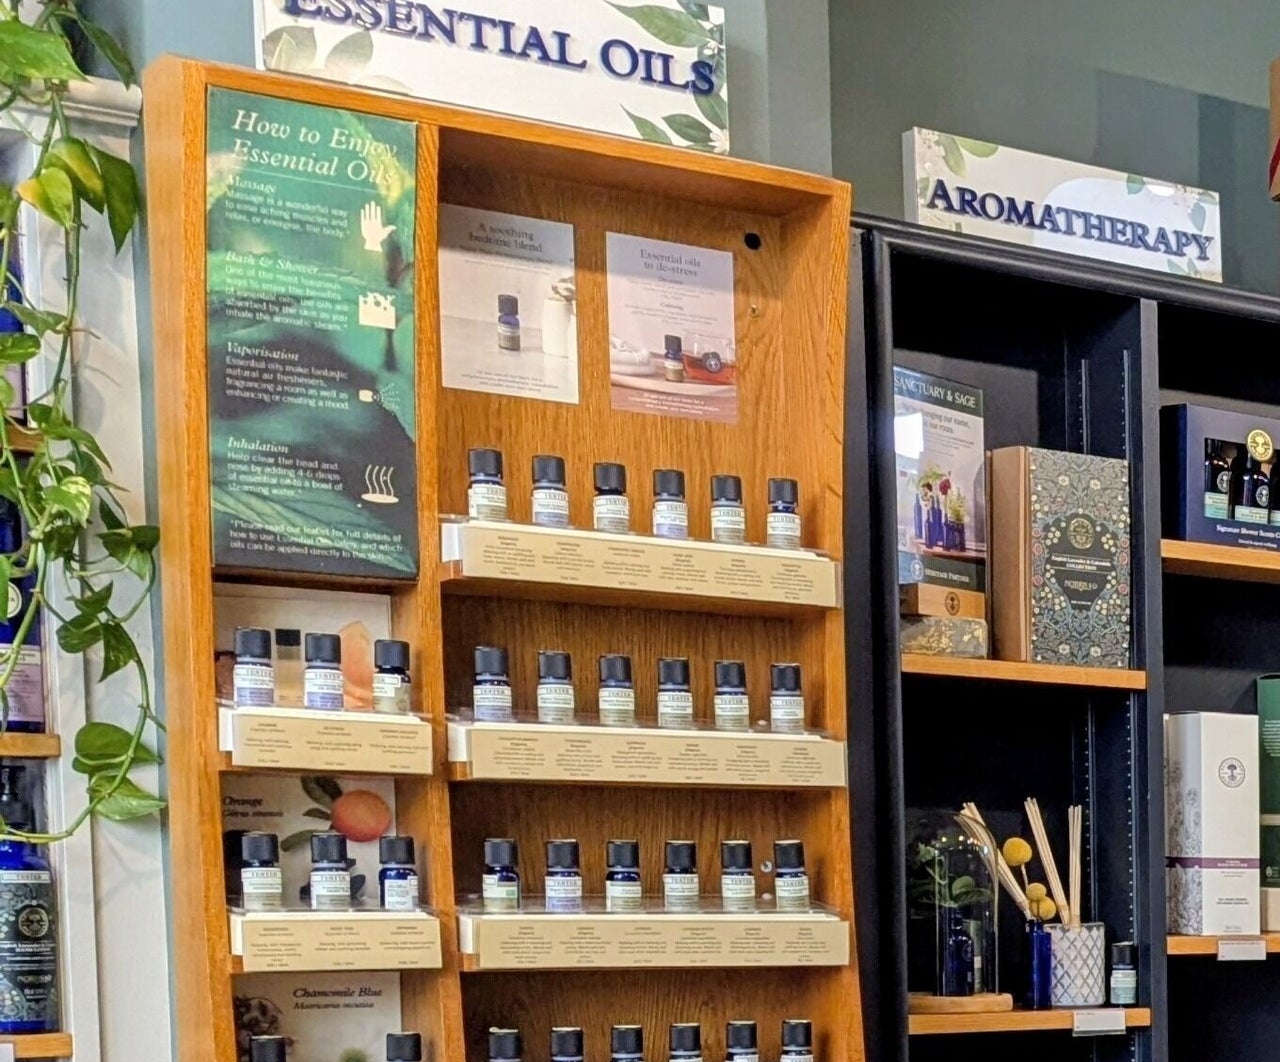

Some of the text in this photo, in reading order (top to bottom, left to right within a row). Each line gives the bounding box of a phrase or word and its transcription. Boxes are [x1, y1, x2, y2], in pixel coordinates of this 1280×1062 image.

[284, 0, 716, 96] ESSENTIAL OILS
[232, 109, 397, 158] How to Enjoy
[232, 138, 392, 186] Essential Oils
[926, 178, 1214, 260] AROMATHERAPY
[469, 231, 543, 253] bedtime blend
[478, 222, 534, 241] A soothing
[225, 252, 255, 265] Bath
[275, 259, 319, 274] Shower
[640, 248, 702, 268] Essential oils
[643, 259, 698, 277] to de-stress
[227, 341, 300, 362] Vaporisation
[894, 376, 976, 408] SANCTUARY & SAGE
[227, 436, 289, 454] Inhalation
[292, 985, 384, 999] Chamomile Blue
